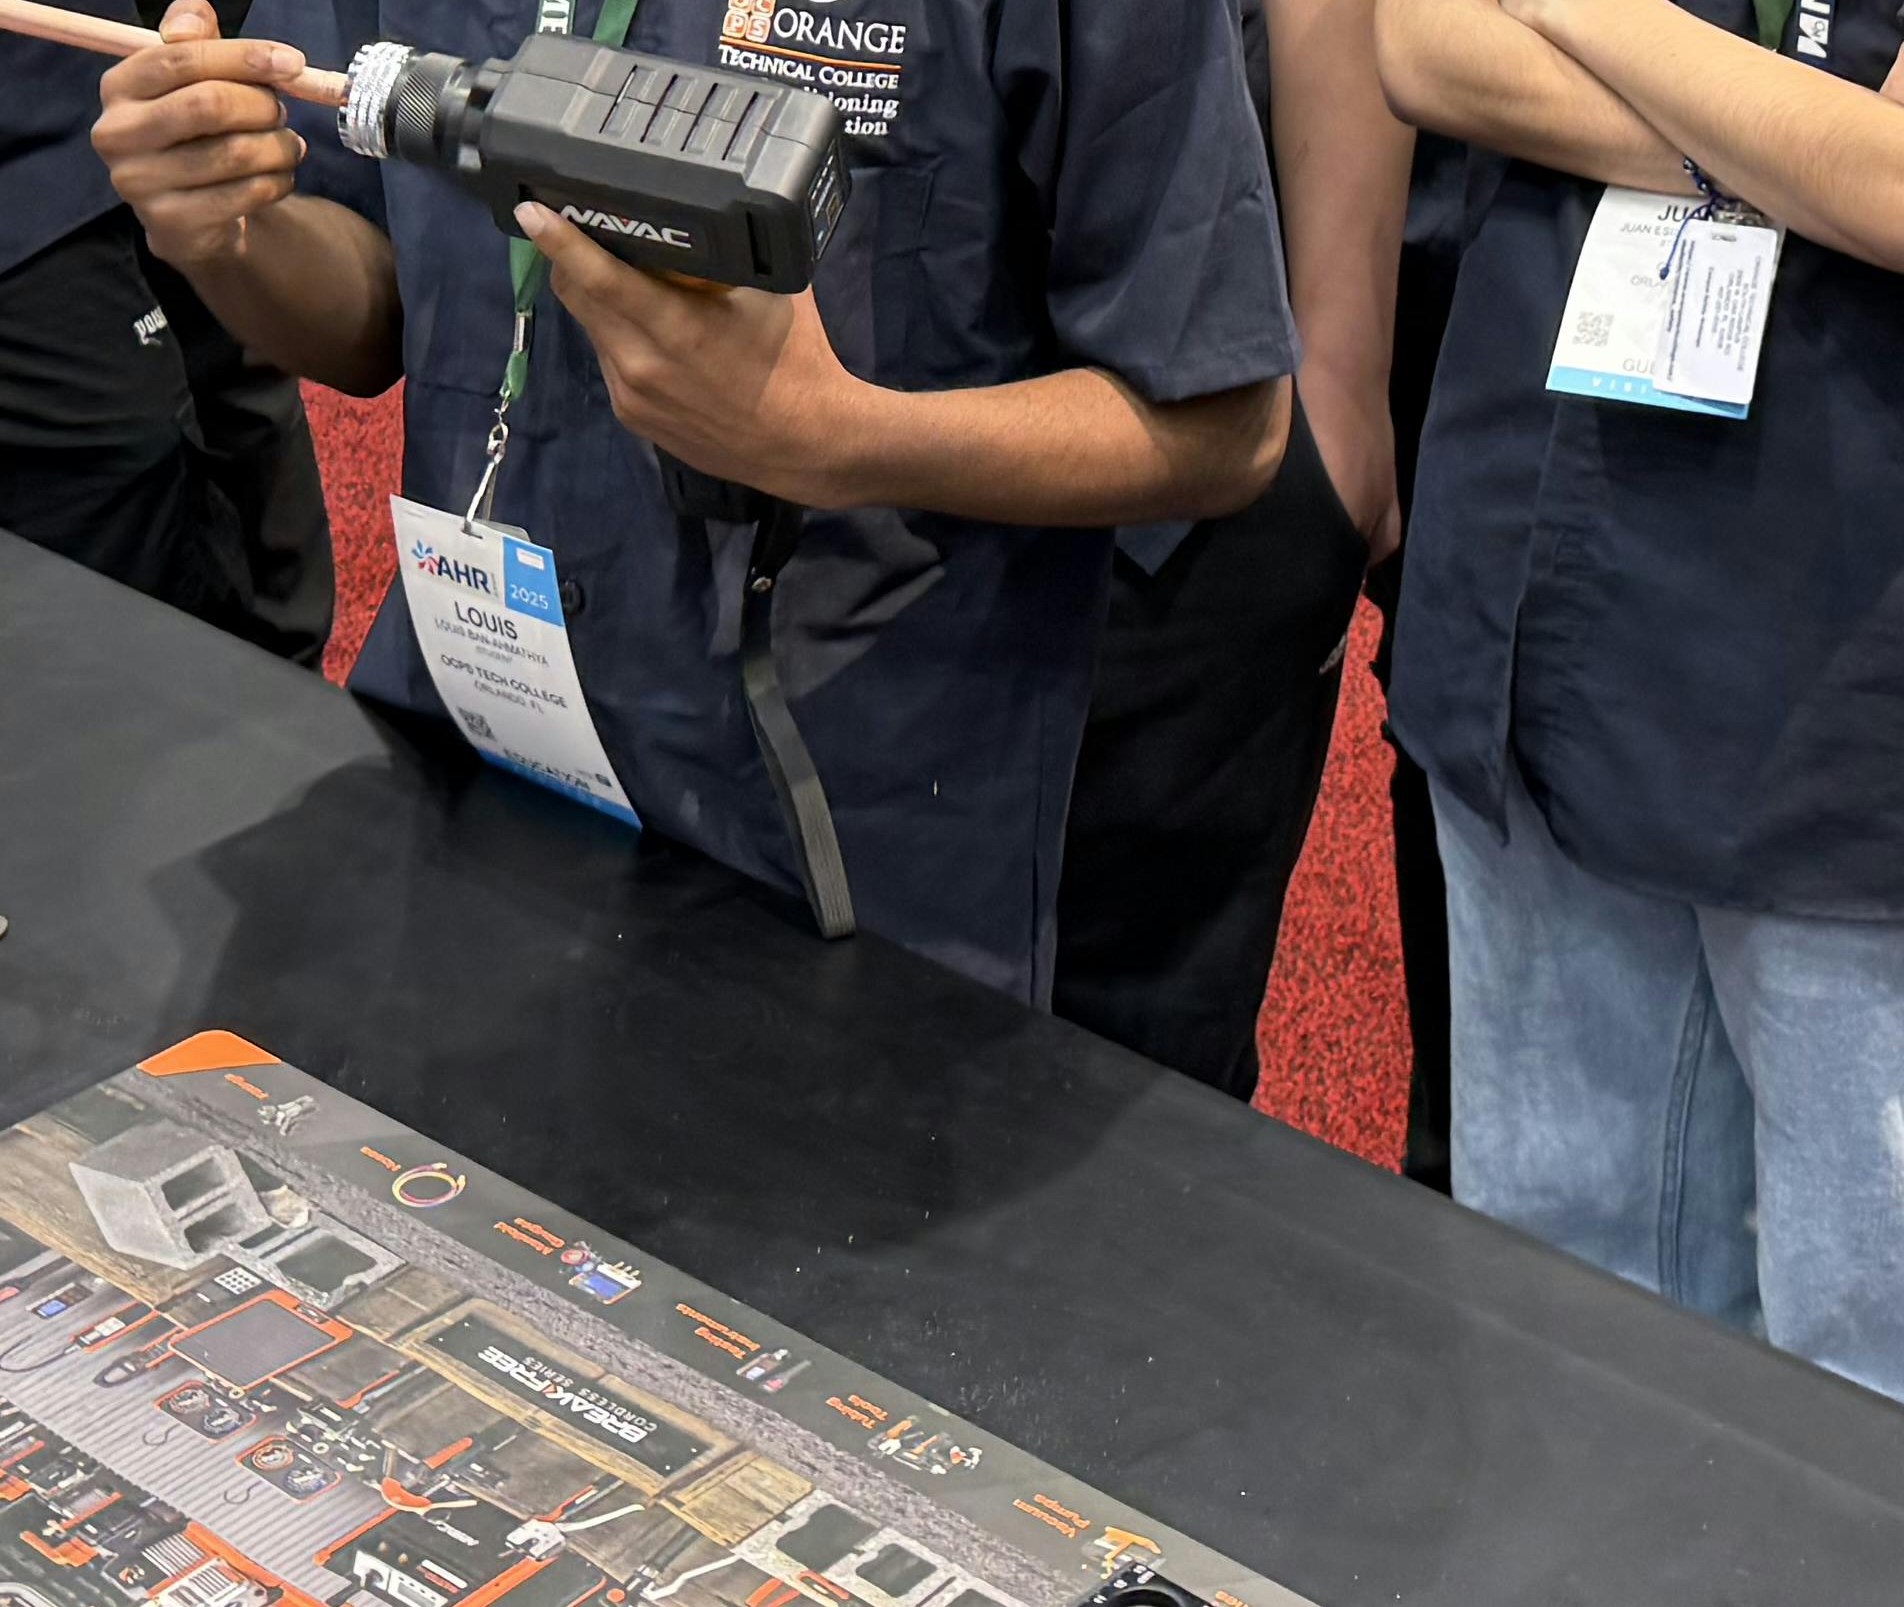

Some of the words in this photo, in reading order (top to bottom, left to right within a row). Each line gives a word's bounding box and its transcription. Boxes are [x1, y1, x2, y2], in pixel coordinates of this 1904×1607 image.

[772, 7, 907, 55] ORANGE
[718, 44, 816, 82] TECHNICAL
[818, 65, 900, 90] COLLEGE
[558, 204, 693, 249] NAVAC
[1619, 222, 1651, 234] JUAN
[437, 554, 492, 595] AHR
[509, 583, 550, 611] 2025
[454, 600, 520, 642] LOUIS
[522, 1355, 576, 1388] SERIES
[576, 1388, 660, 1436] CORDLESS
